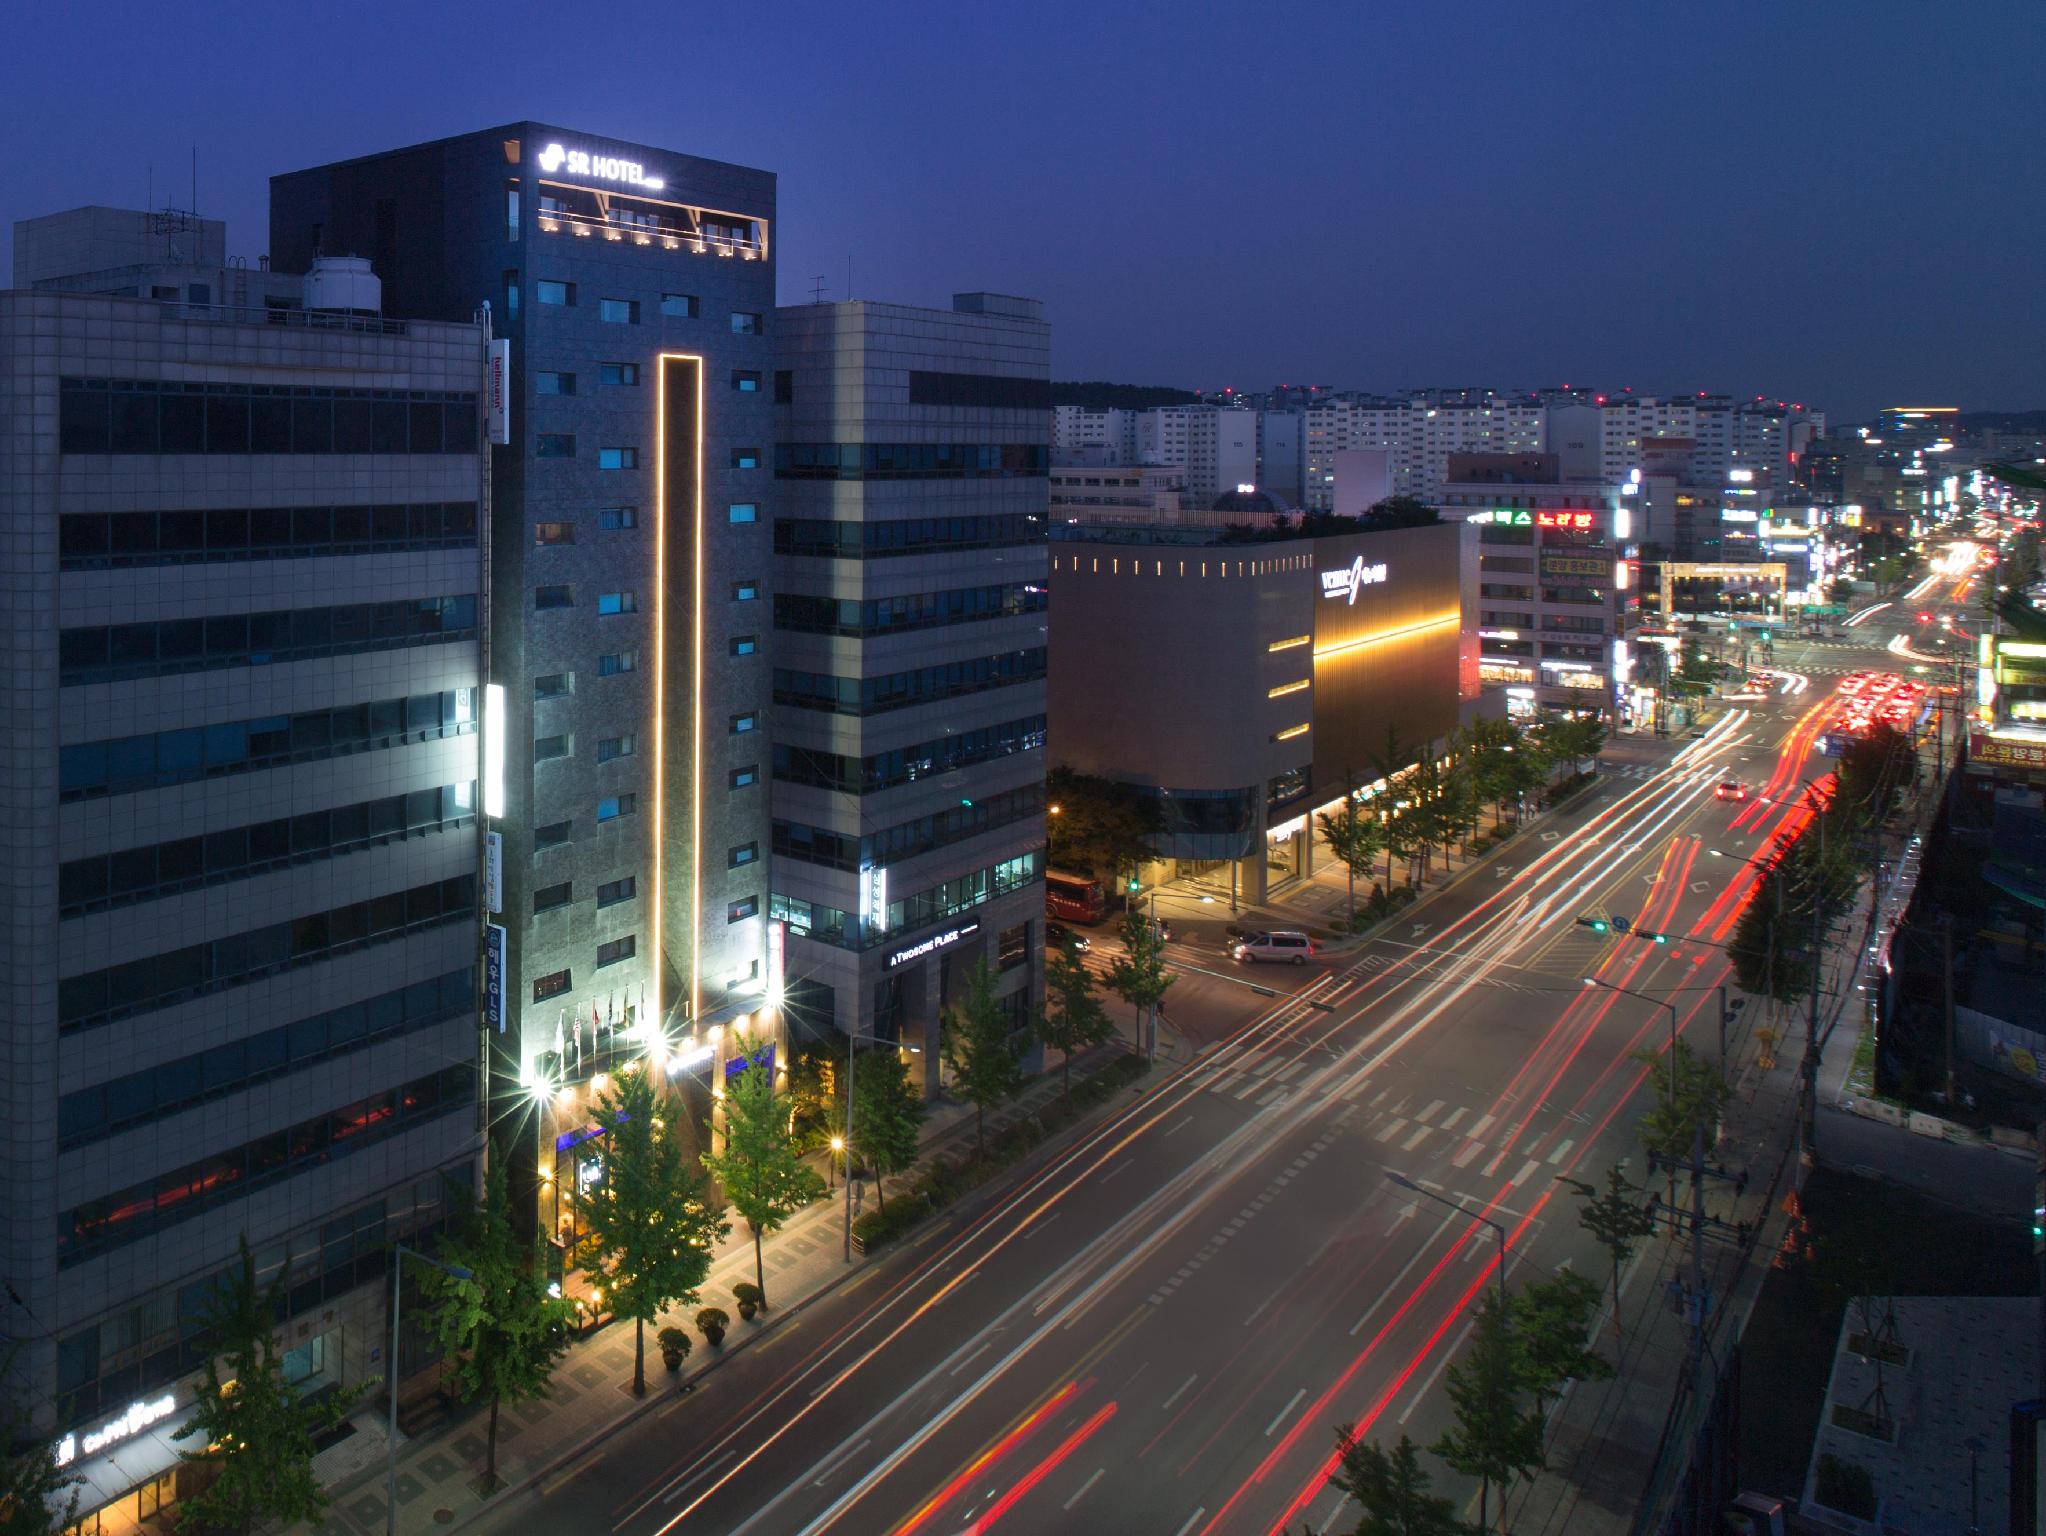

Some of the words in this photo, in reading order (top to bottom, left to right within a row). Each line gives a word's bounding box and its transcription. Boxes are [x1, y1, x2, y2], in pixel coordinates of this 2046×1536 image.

[567, 150, 590, 175] SR
[593, 156, 644, 185] HOTEL
[891, 956, 897, 966] A
